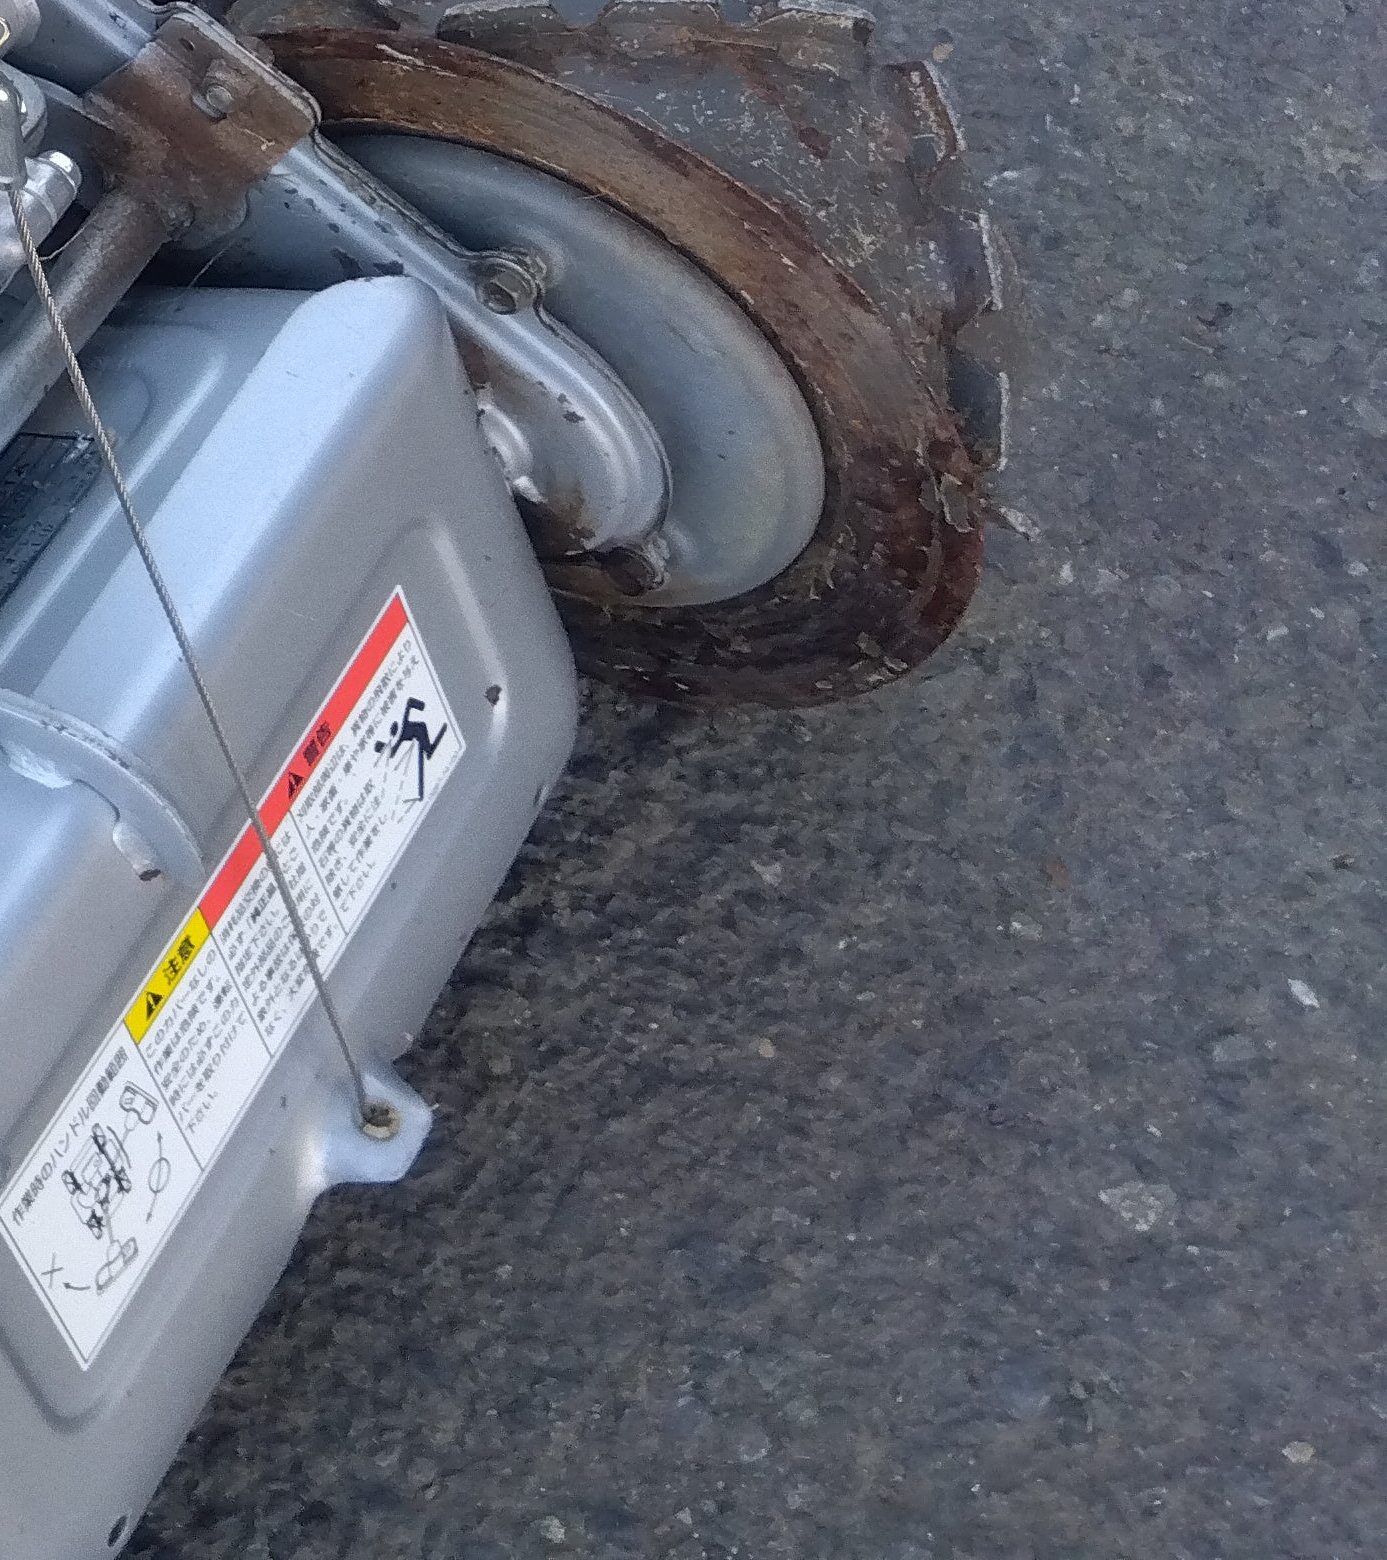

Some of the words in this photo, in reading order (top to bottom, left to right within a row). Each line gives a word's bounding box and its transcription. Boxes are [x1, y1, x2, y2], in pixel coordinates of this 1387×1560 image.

[161, 933, 196, 986] 注意
[144, 947, 217, 1059] このカバーなしの
[184, 1082, 219, 1135] 下さい。
